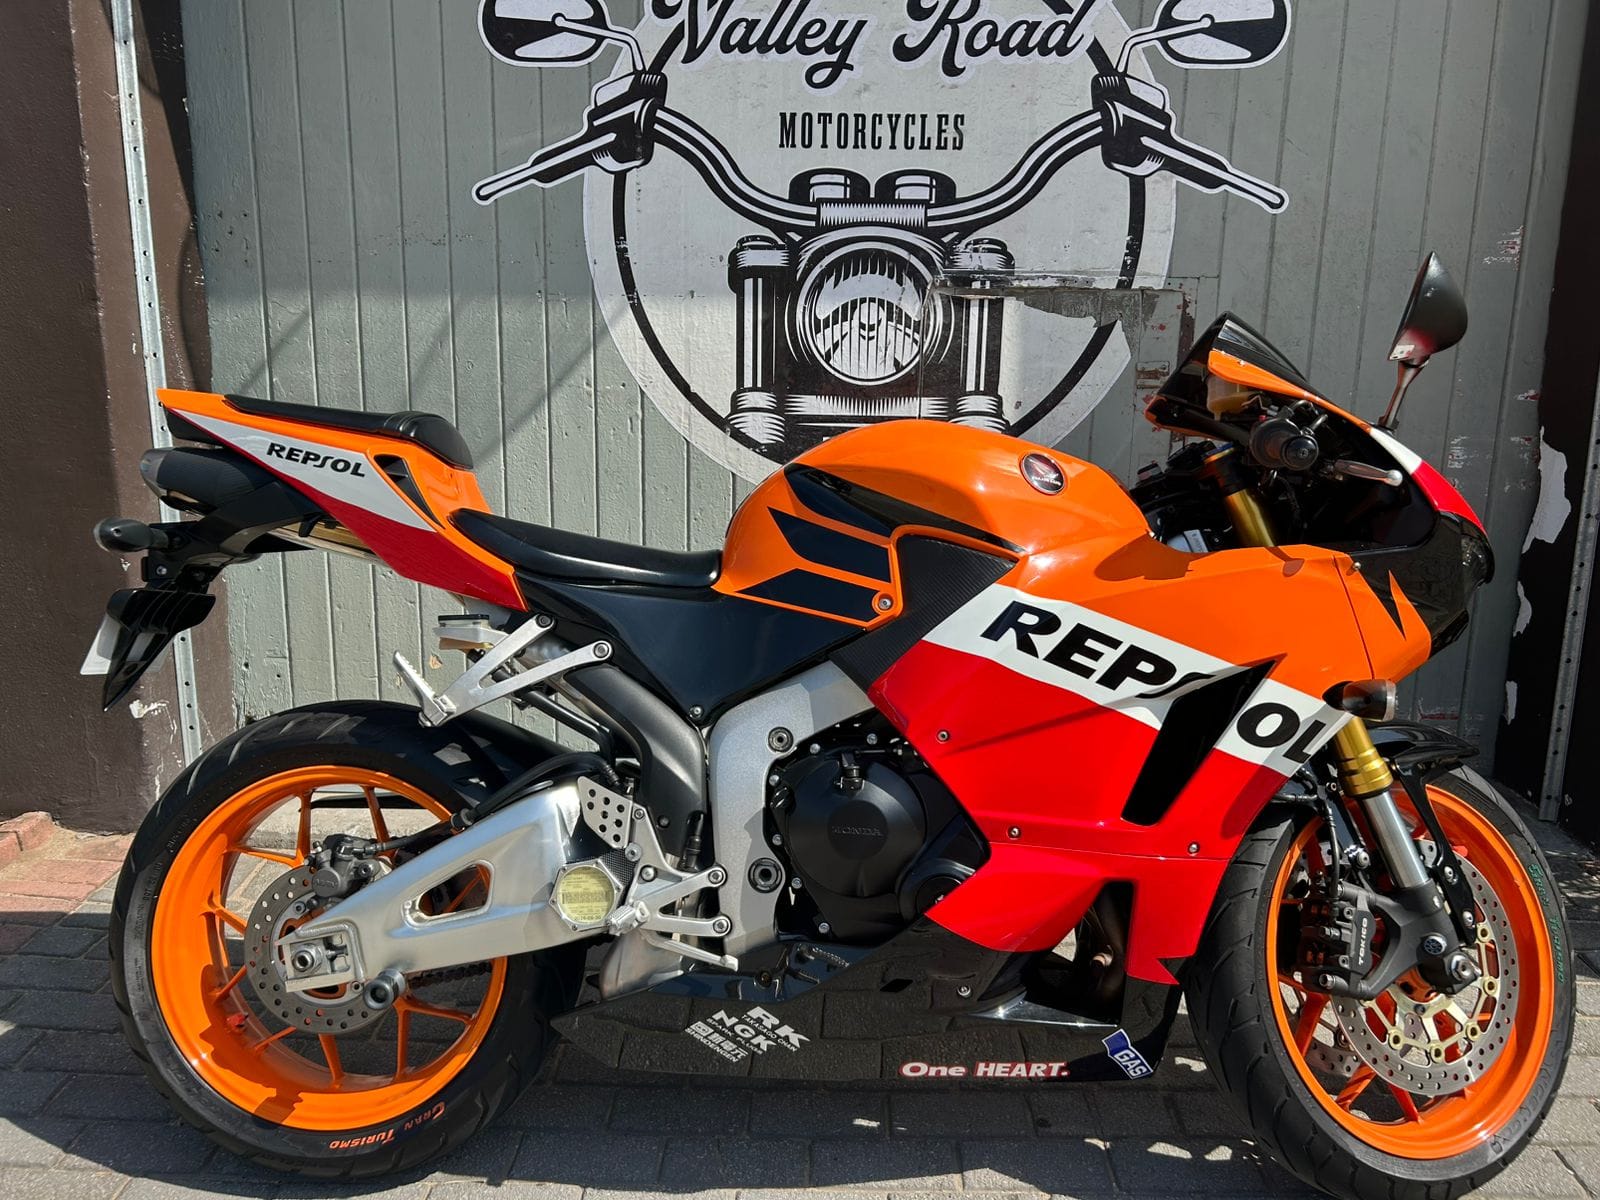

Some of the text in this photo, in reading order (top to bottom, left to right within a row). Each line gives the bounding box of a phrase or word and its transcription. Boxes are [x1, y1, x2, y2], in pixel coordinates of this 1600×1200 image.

[652, 0, 1096, 89] Valley Road
[778, 112, 965, 151] MOTORCYCLES
[266, 442, 365, 478] REPSOL
[1358, 917, 1368, 966] TOKICO
[684, 1027, 739, 1063] SHINDENGEN
[706, 1018, 764, 1055] SPARK PLUGS
[711, 1009, 777, 1052] NGK
[741, 1014, 798, 1053] TAKASAGO CHAIN
[746, 1006, 811, 1049] RK
[902, 1061, 1068, 1077] One HEART.
[1114, 1049, 1148, 1077] GAS
